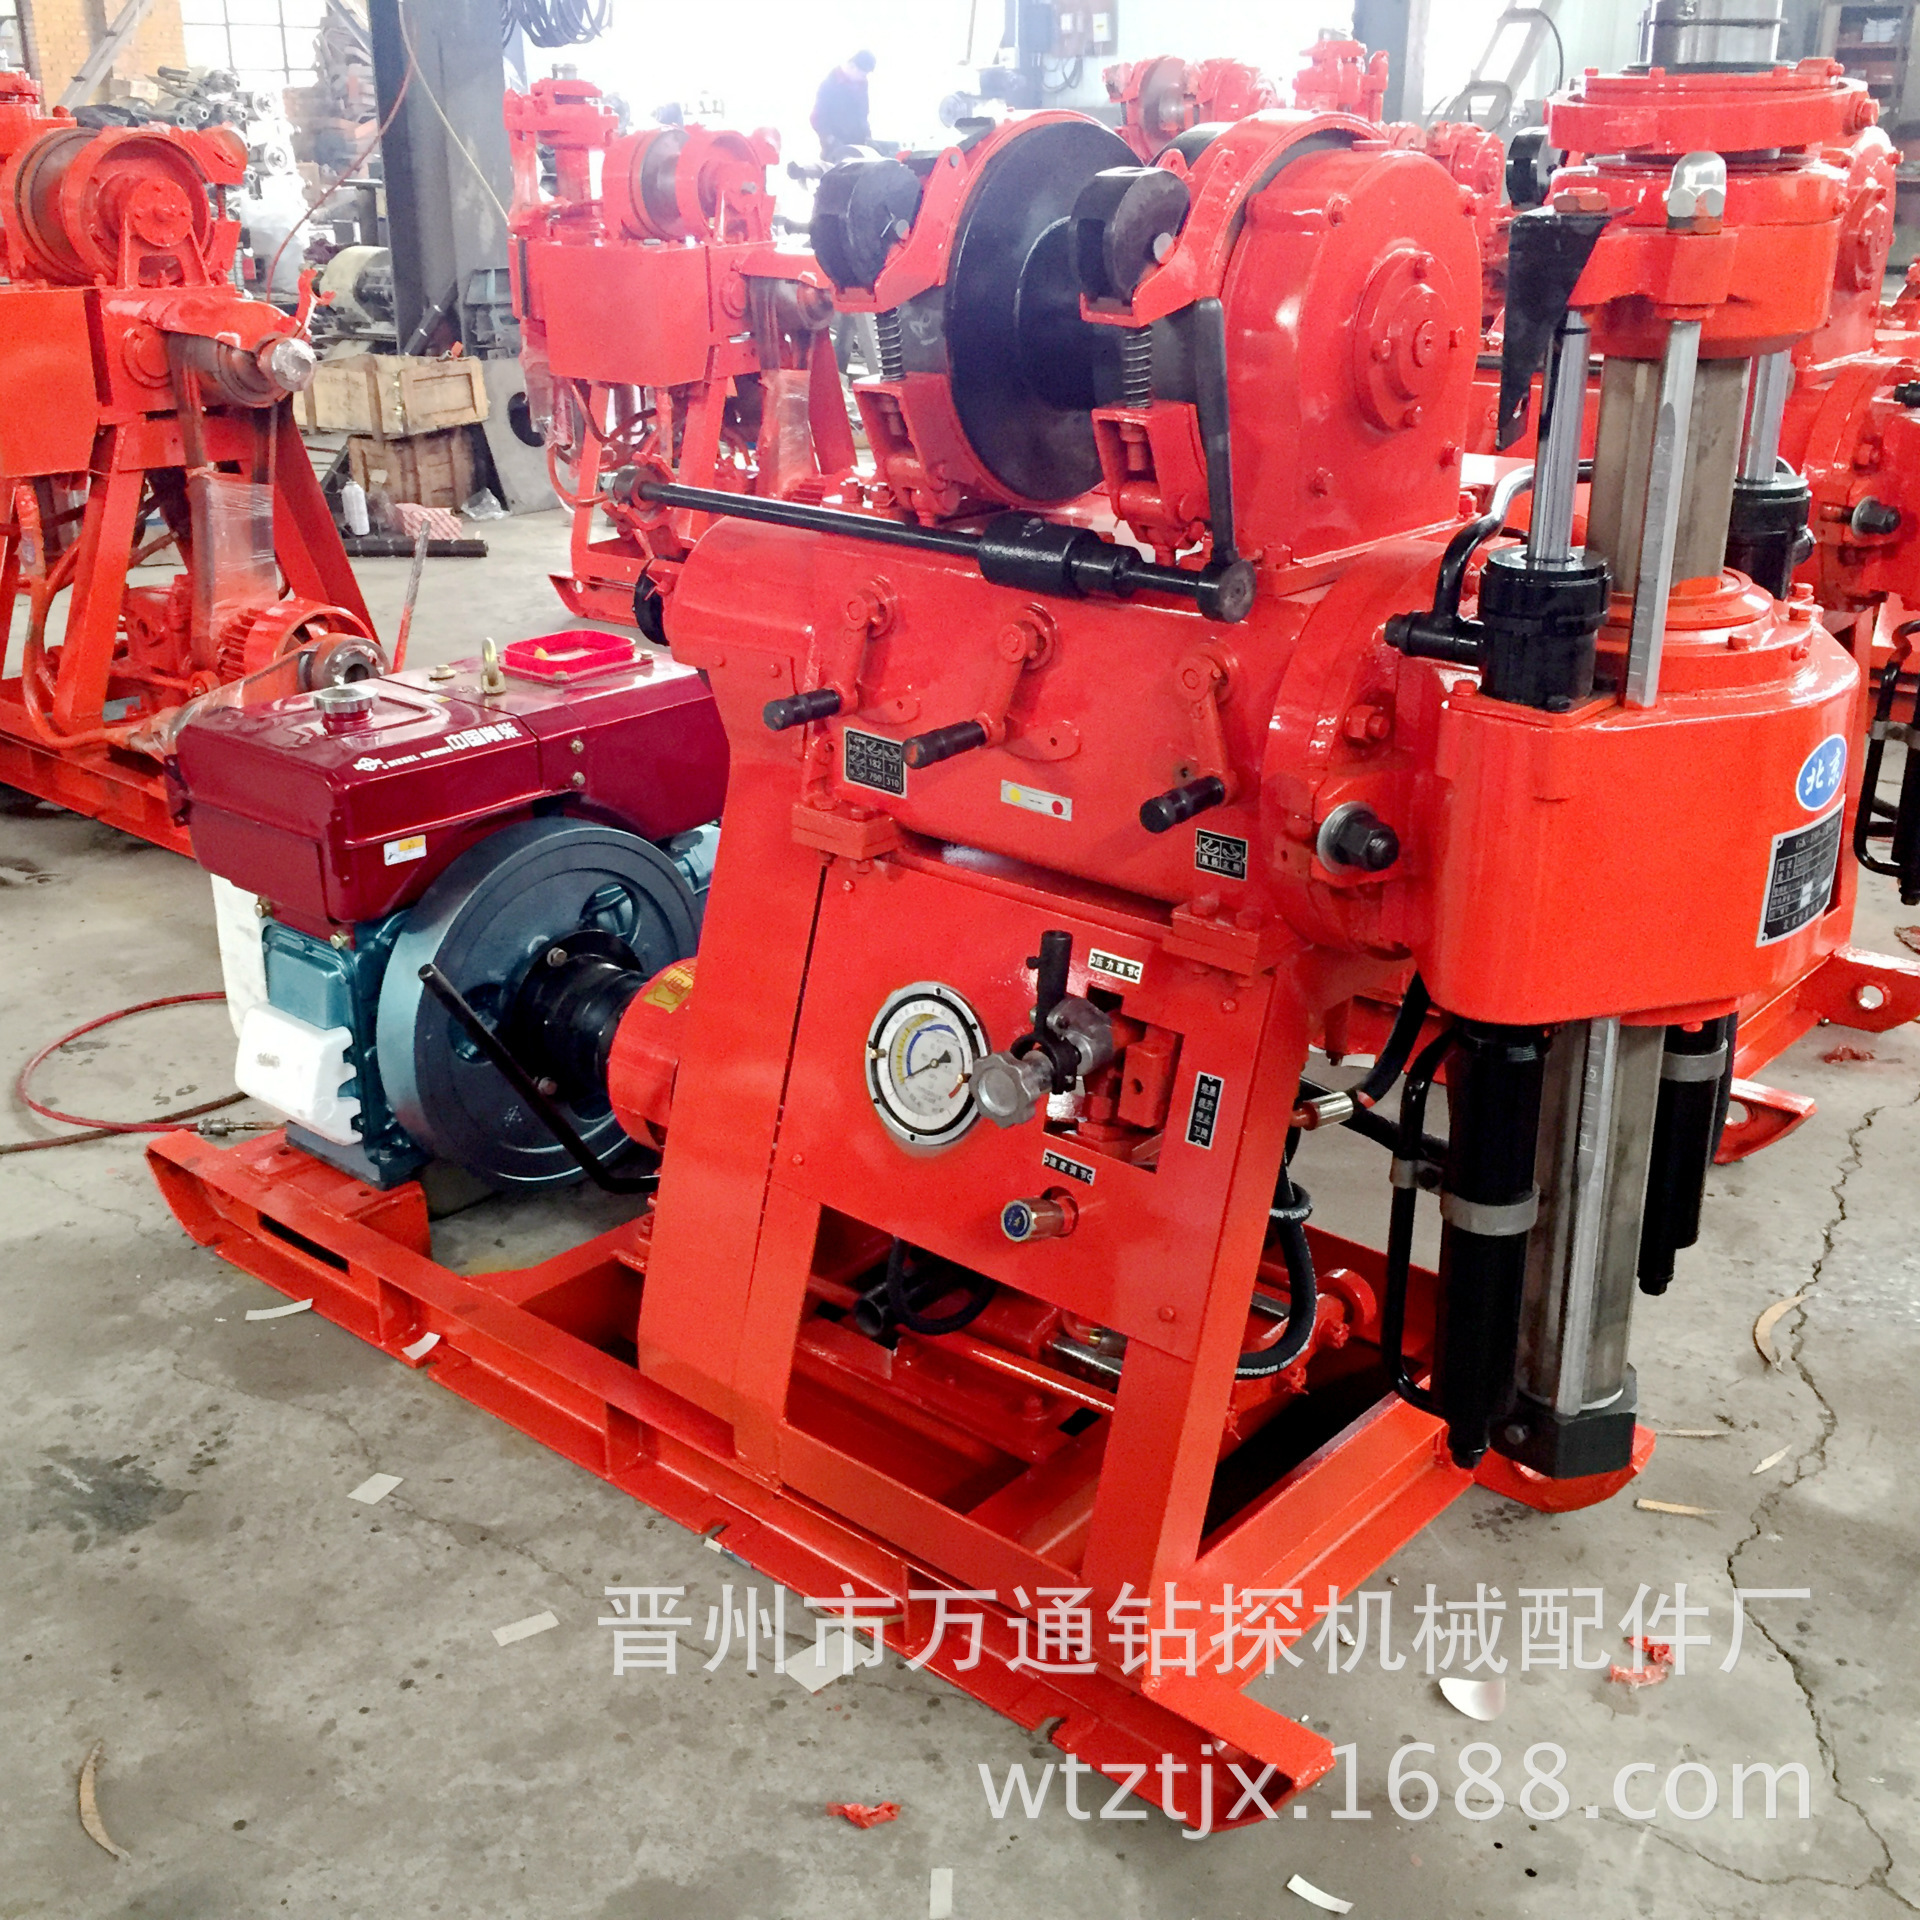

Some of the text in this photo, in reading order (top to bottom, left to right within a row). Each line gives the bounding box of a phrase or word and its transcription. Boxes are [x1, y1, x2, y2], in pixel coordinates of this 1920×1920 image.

[1805, 747, 1840, 796] 北京
[1095, 956, 1136, 977] 压力调节
